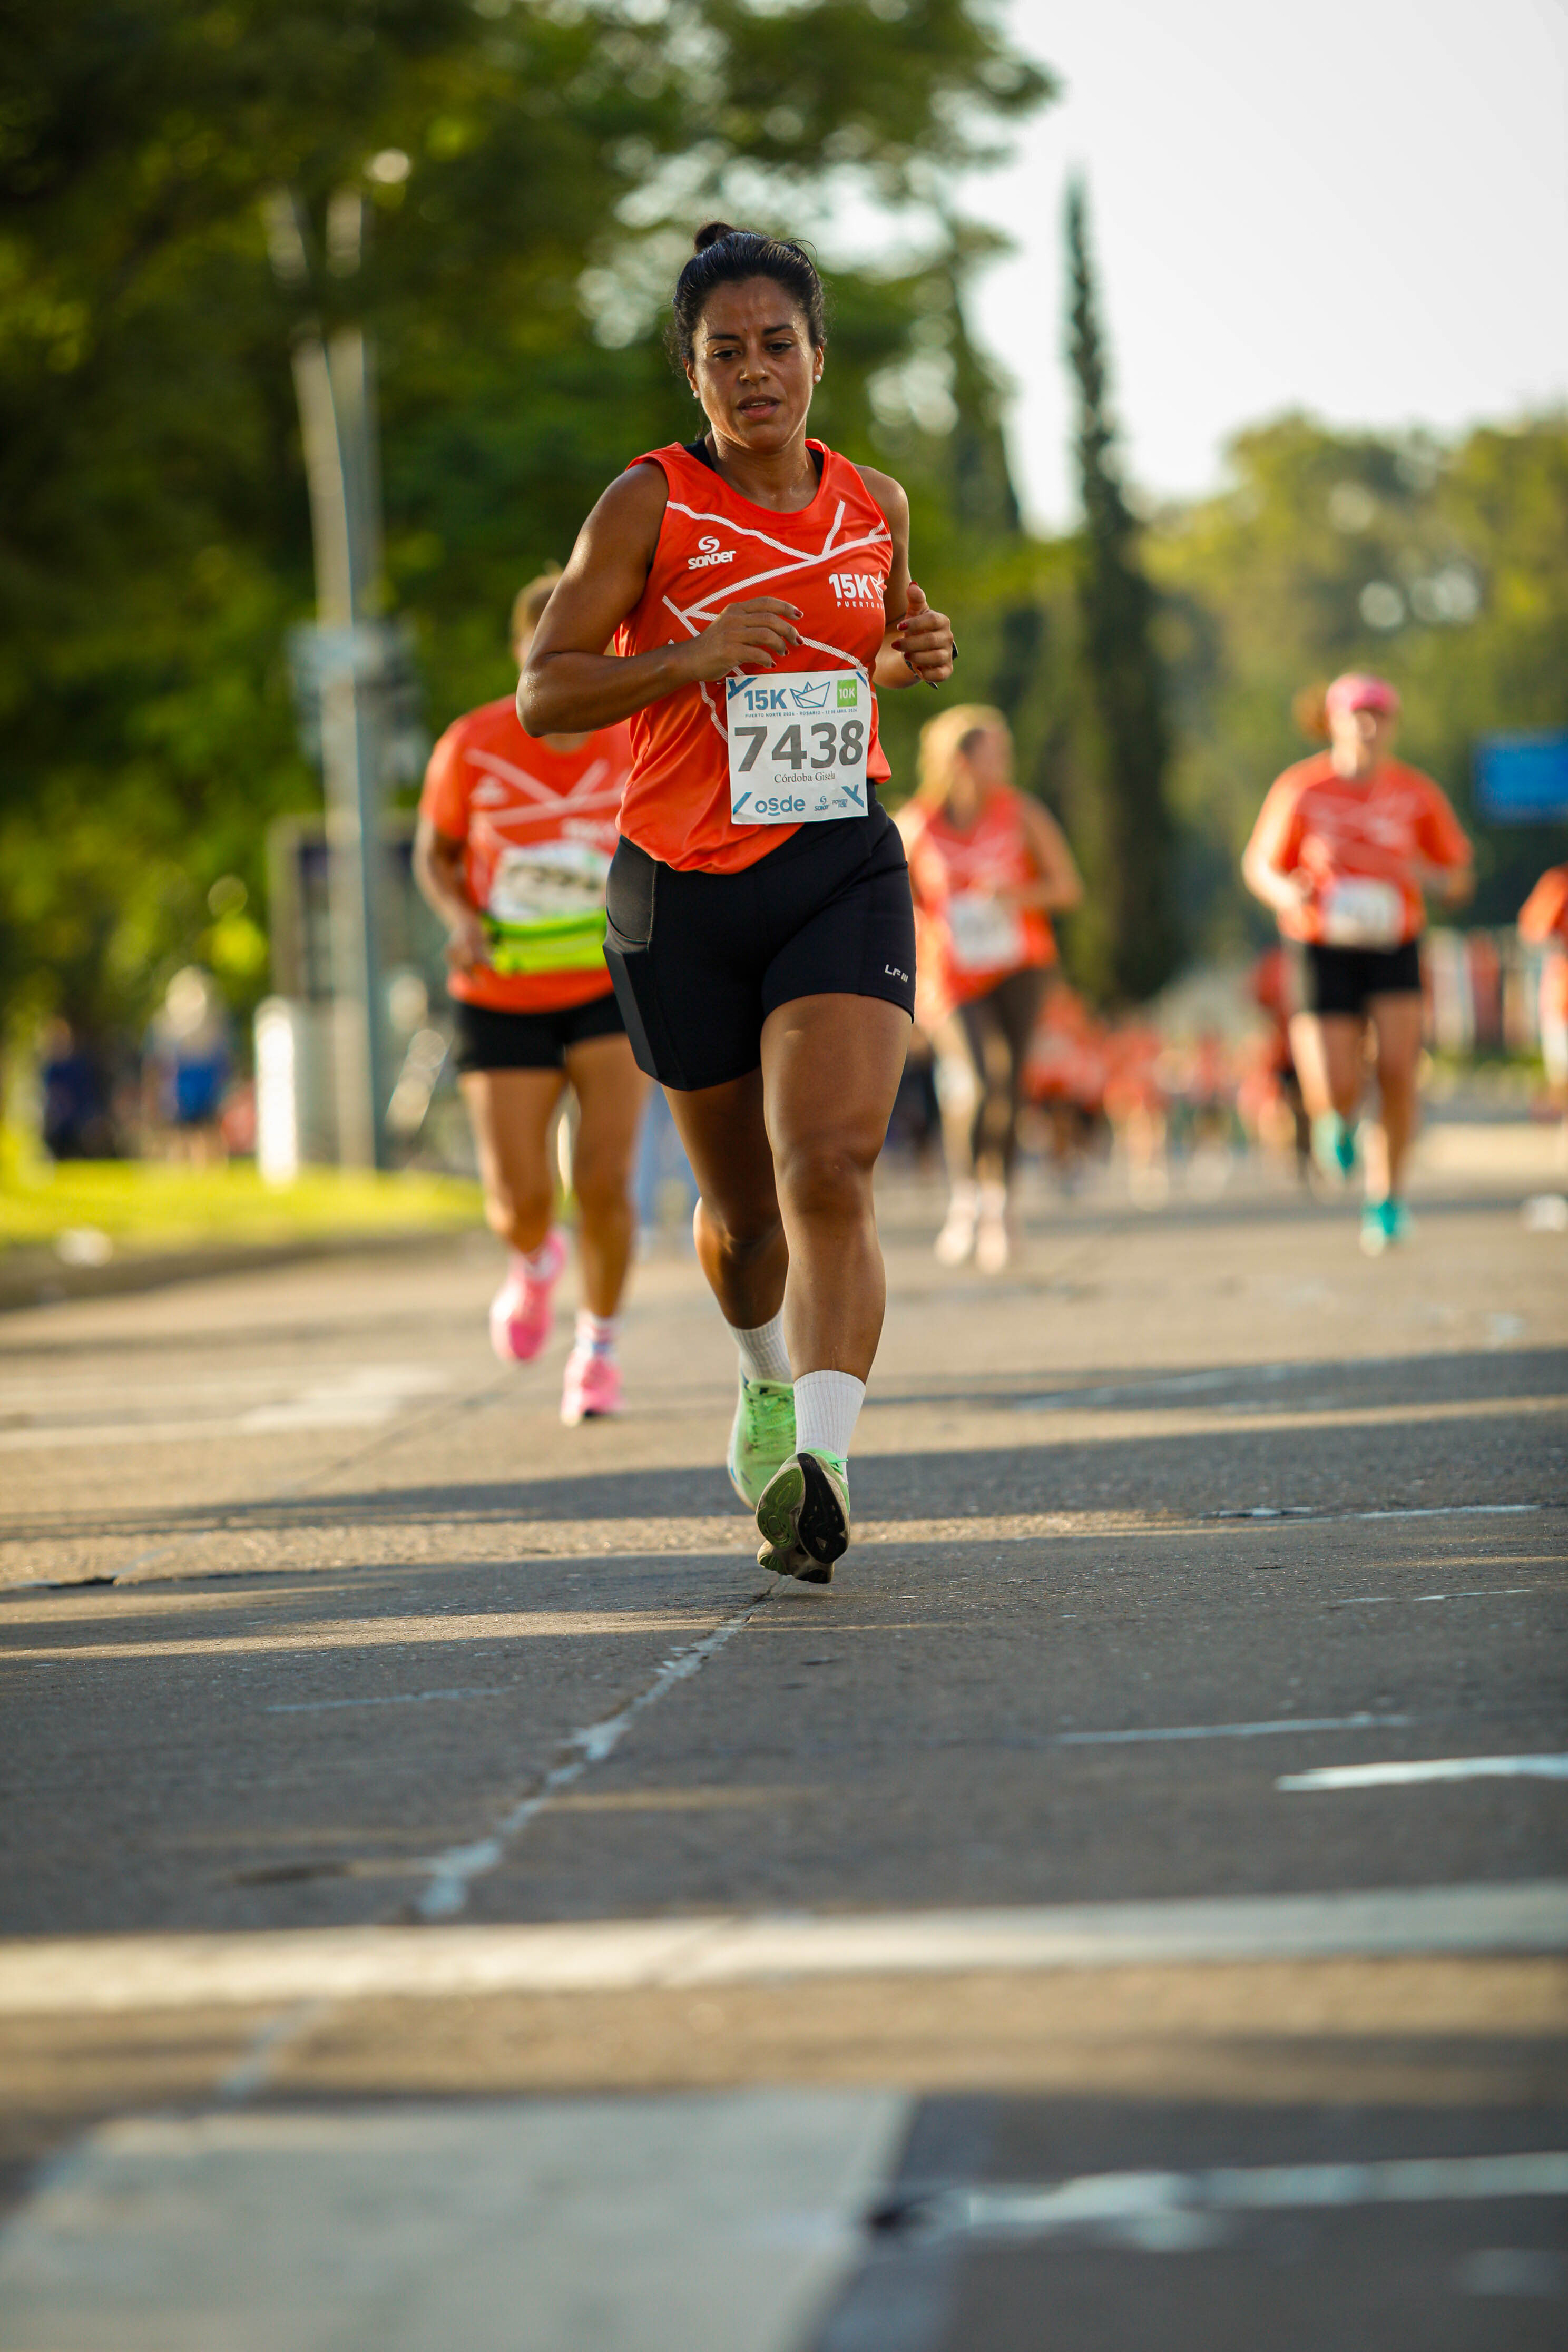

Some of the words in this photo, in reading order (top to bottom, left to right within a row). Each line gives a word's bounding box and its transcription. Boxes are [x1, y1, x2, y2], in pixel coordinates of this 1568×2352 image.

[828, 573, 873, 599] 15K
[744, 688, 787, 711] 15K
[839, 687, 856, 699] 10K
[734, 719, 864, 772] 7438
[774, 772, 812, 783] Córdoba
[815, 771, 835, 781] Gisela
[754, 794, 806, 814] osde
